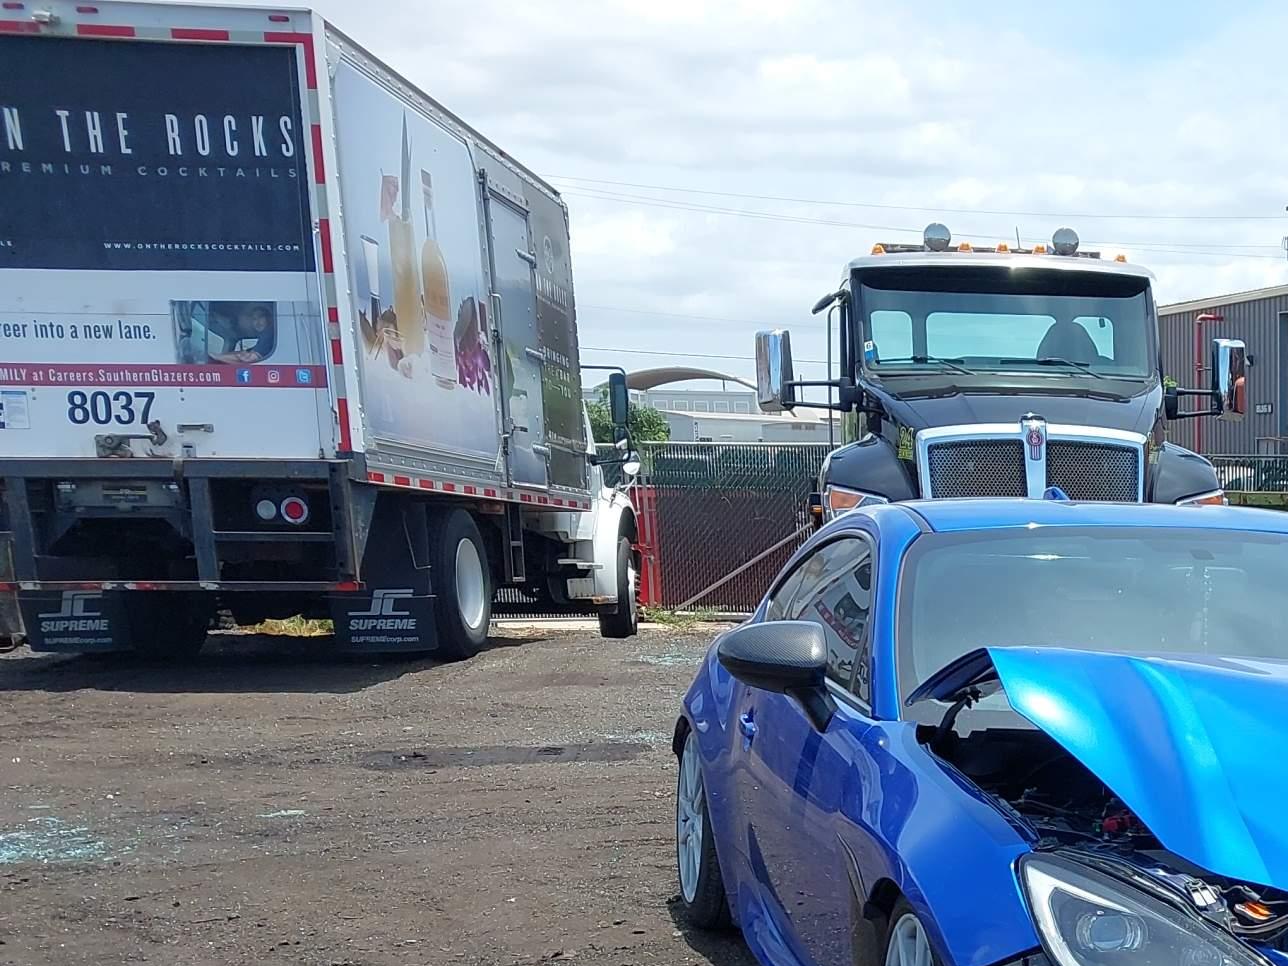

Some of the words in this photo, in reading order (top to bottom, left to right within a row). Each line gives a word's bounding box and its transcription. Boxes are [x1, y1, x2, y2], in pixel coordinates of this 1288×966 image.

[56, 110, 132, 153] THE
[165, 114, 294, 157] ROCKS
[1, 161, 111, 174] REMIUM
[137, 166, 297, 177] COCKTAILS
[0, 323, 27, 338] eer
[33, 320, 64, 338] into
[70, 325, 78, 338] a
[83, 324, 113, 339] new
[119, 321, 156, 339] lane.
[32, 370, 43, 381] at
[48, 368, 221, 383] Careers.SouthernGlazers.com
[67, 391, 155, 424] 8037
[41, 620, 109, 632] SUPREME
[349, 619, 416, 630] SUPREME
